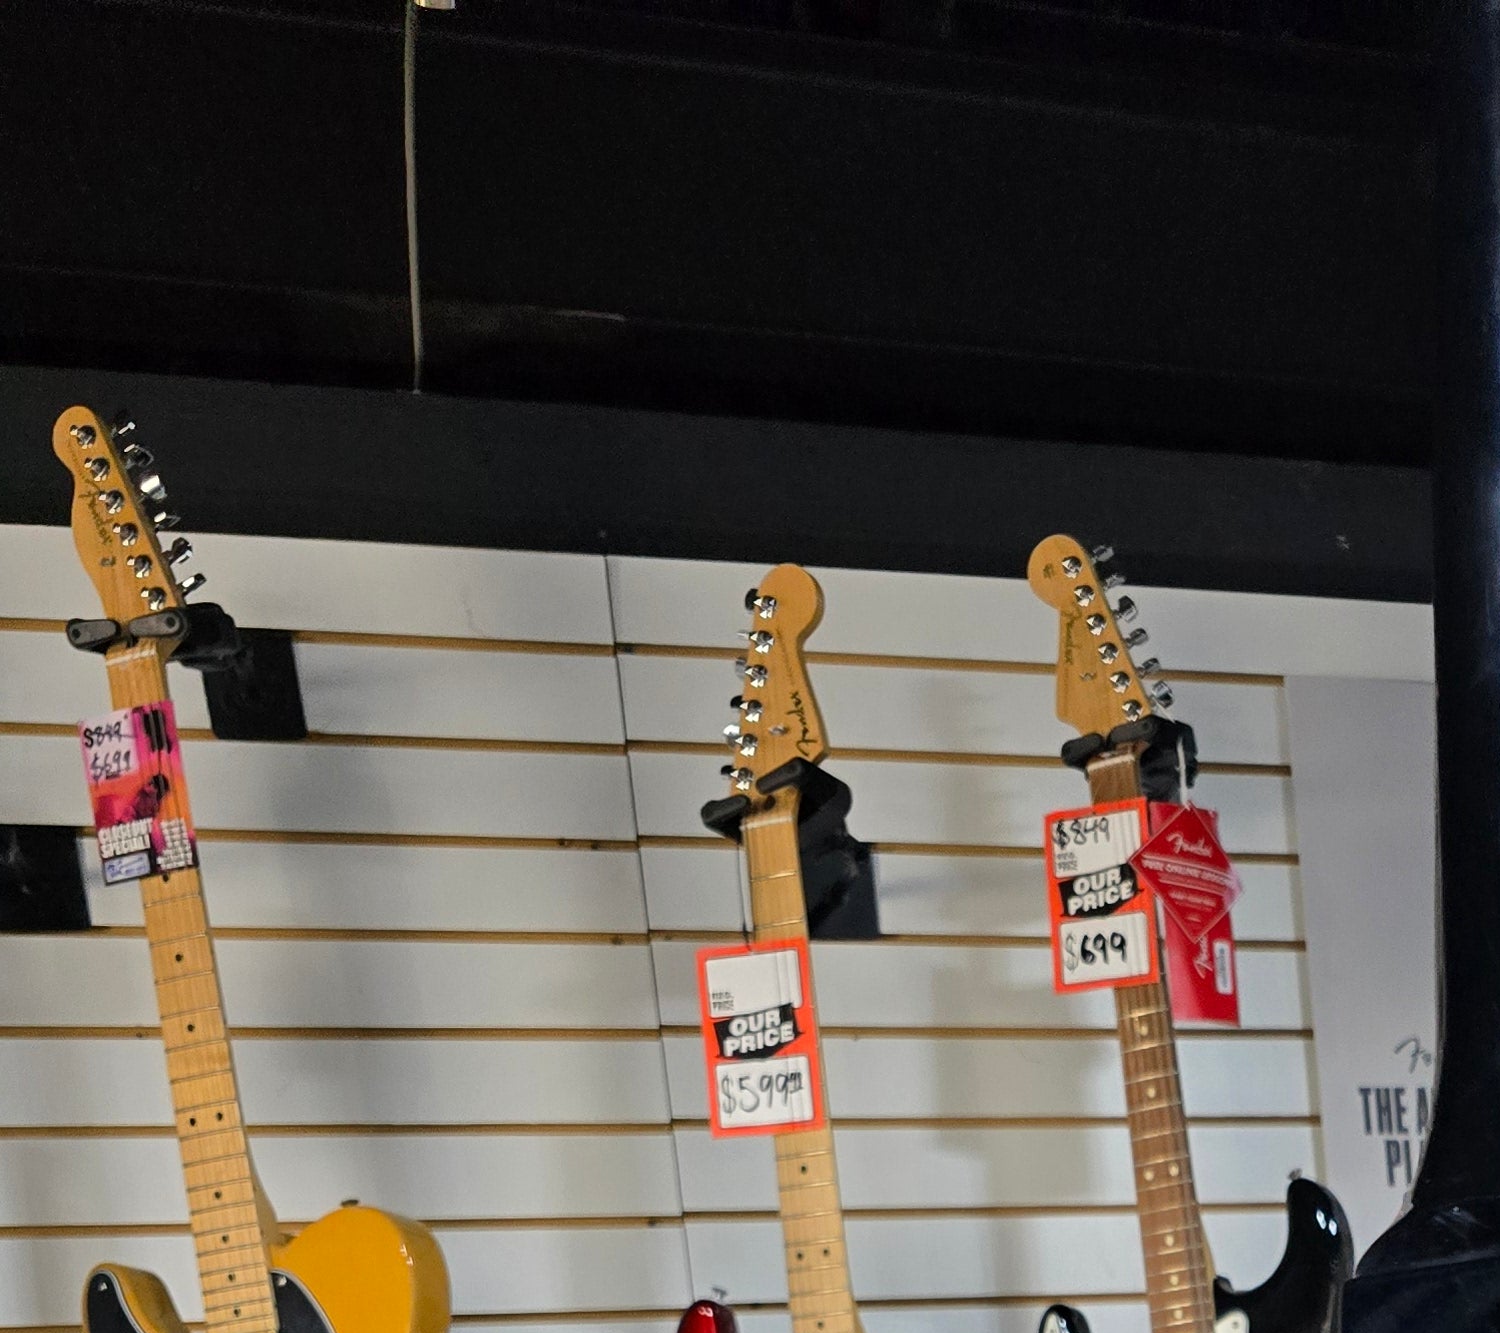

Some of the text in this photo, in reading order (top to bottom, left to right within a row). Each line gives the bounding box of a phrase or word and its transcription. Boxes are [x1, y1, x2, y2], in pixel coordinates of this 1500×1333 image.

[787, 691, 818, 758] Fender
[1053, 816, 1111, 848] $849
[1066, 878, 1134, 916] PRICE
[1072, 866, 1122, 896] OUR
[1065, 931, 1128, 973] $699
[723, 1022, 795, 1058] PRICE
[728, 1007, 781, 1038] OUR
[1358, 1087, 1408, 1136] THE
